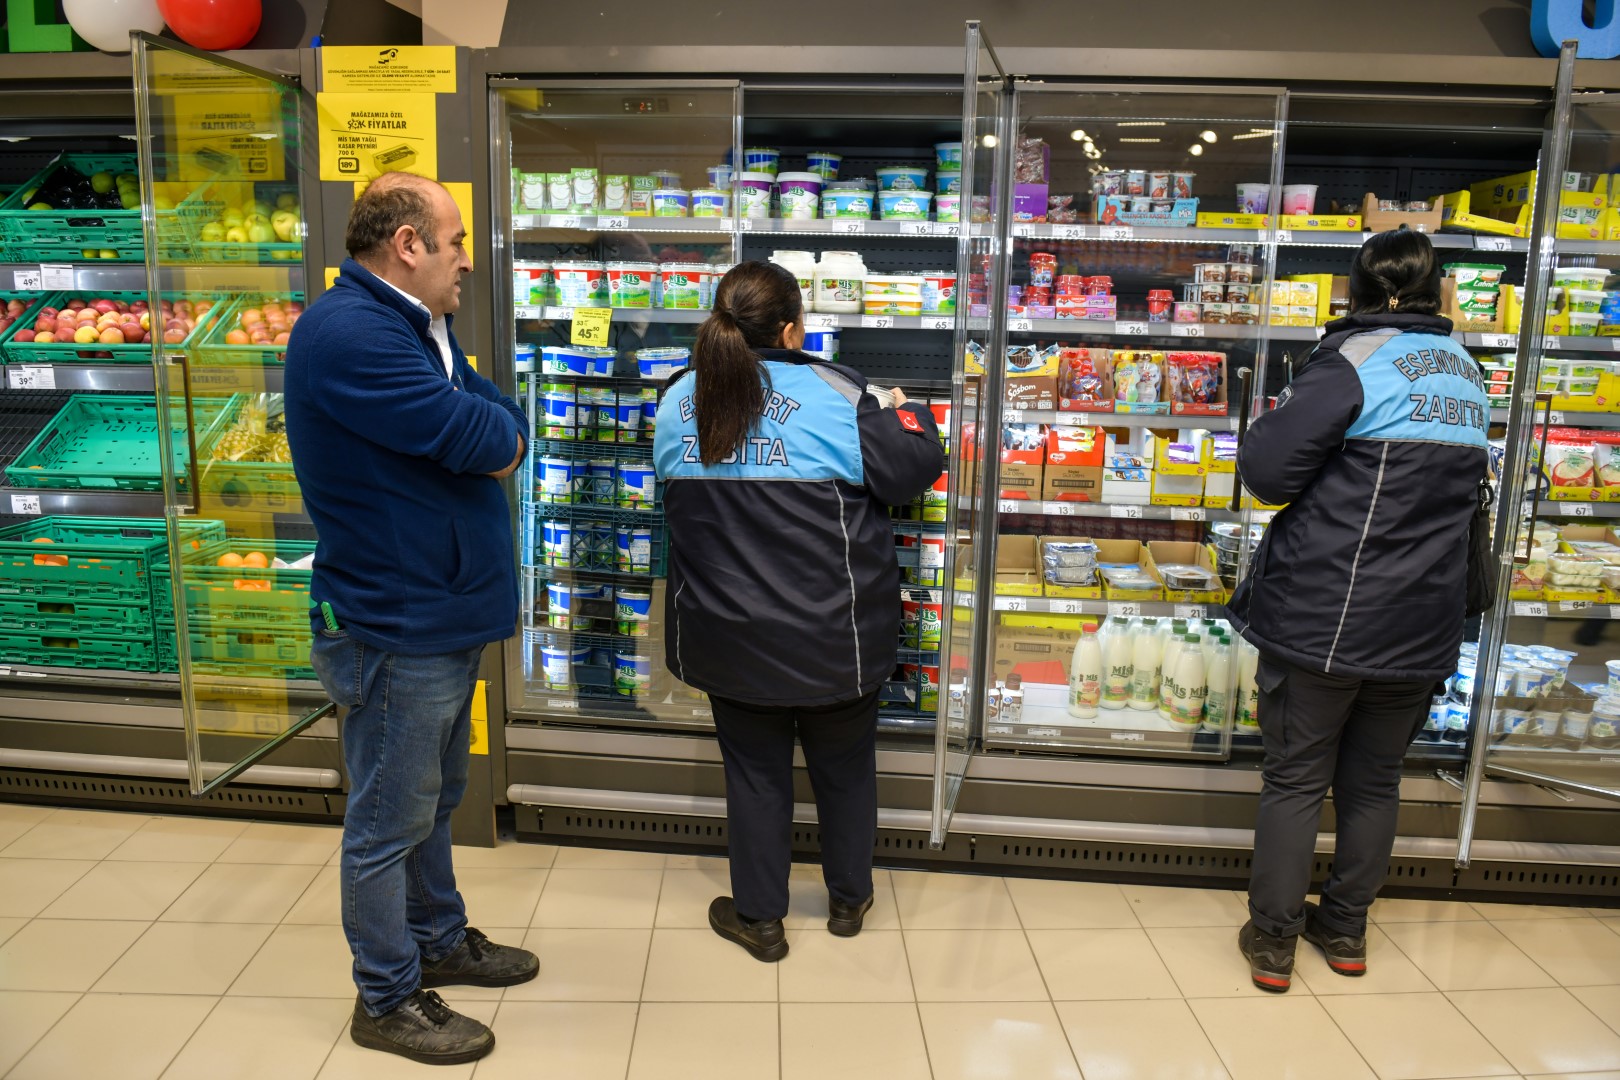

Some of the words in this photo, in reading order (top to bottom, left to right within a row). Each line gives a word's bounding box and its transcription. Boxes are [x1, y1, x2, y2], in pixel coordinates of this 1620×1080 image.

[390, 110, 403, 118] ÖZEL
[368, 118, 407, 129] FİYATLAR
[621, 274, 640, 286] Mis
[669, 274, 688, 286] Mis
[600, 410, 610, 421] is
[1410, 394, 1484, 432] ZABITA
[682, 435, 789, 466] ZITA
[618, 604, 634, 615] Mis
[1009, 602, 1020, 610] 37
[1066, 604, 1075, 612] 21
[1122, 606, 1134, 615] 22
[916, 608, 938, 622] Mis
[1190, 609, 1200, 618] 21
[620, 666, 636, 677] Mis
